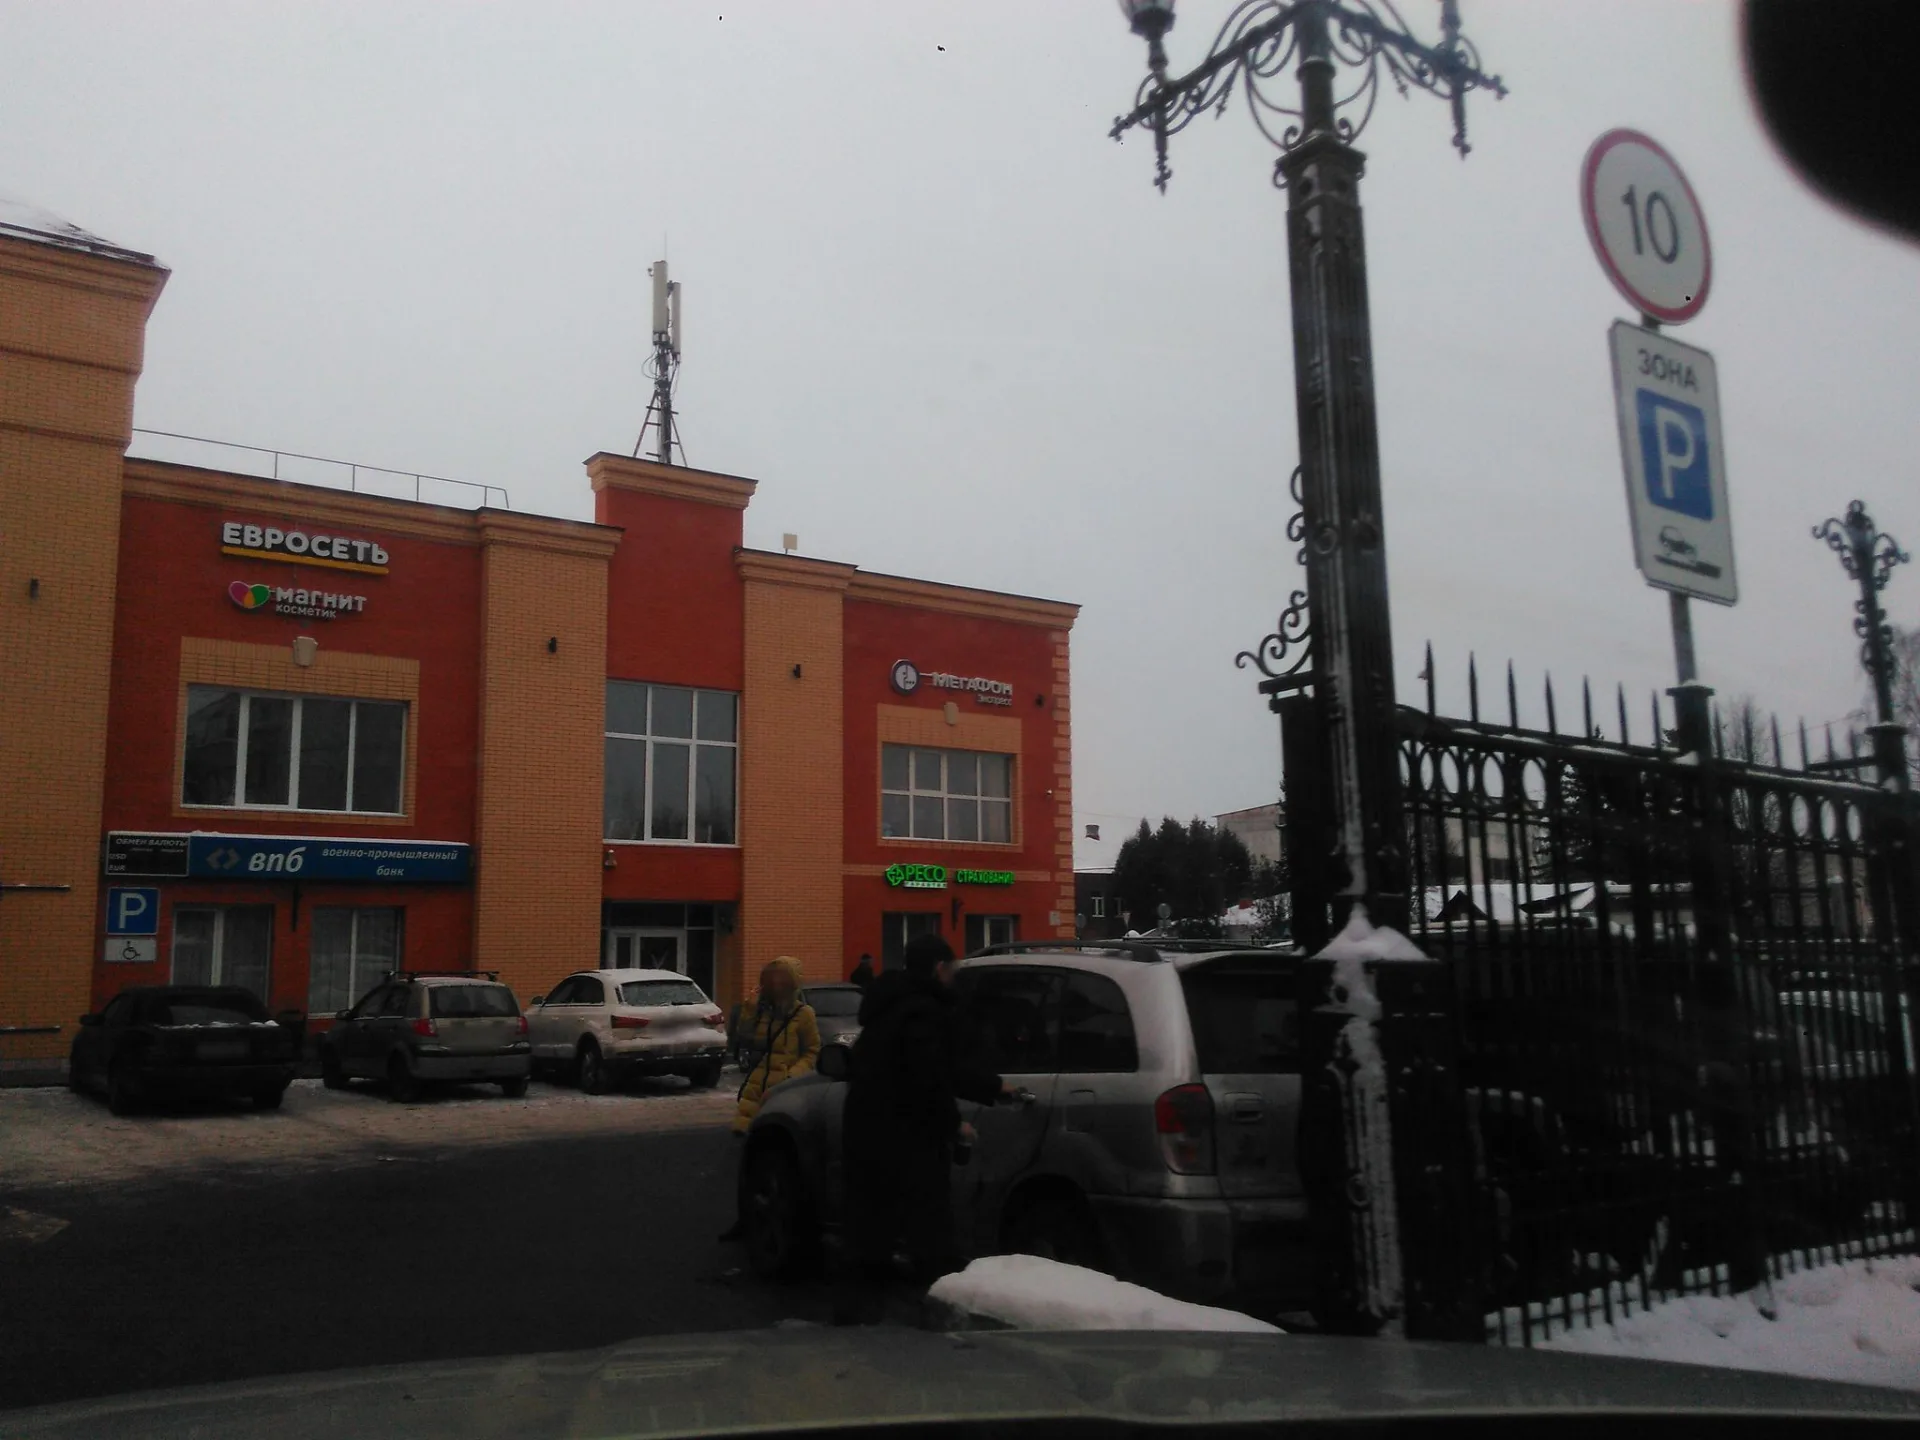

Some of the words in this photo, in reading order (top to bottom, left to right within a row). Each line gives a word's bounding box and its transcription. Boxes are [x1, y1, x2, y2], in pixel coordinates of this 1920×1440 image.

[1620, 184, 1680, 264] 10
[1637, 348, 1699, 393] ЗОНА
[1654, 404, 1695, 499] P
[222, 522, 389, 565] ЕВРОСЕТЬ
[931, 671, 1013, 696] МЕГАФОН
[116, 838, 147, 846] ОБМЕН
[148, 839, 189, 847] ВАЛЮТЫ
[321, 848, 459, 861] военно-промышленный
[248, 846, 307, 873] впб
[376, 865, 405, 876] банк
[905, 864, 946, 882] РЕСО
[118, 892, 148, 929] P
